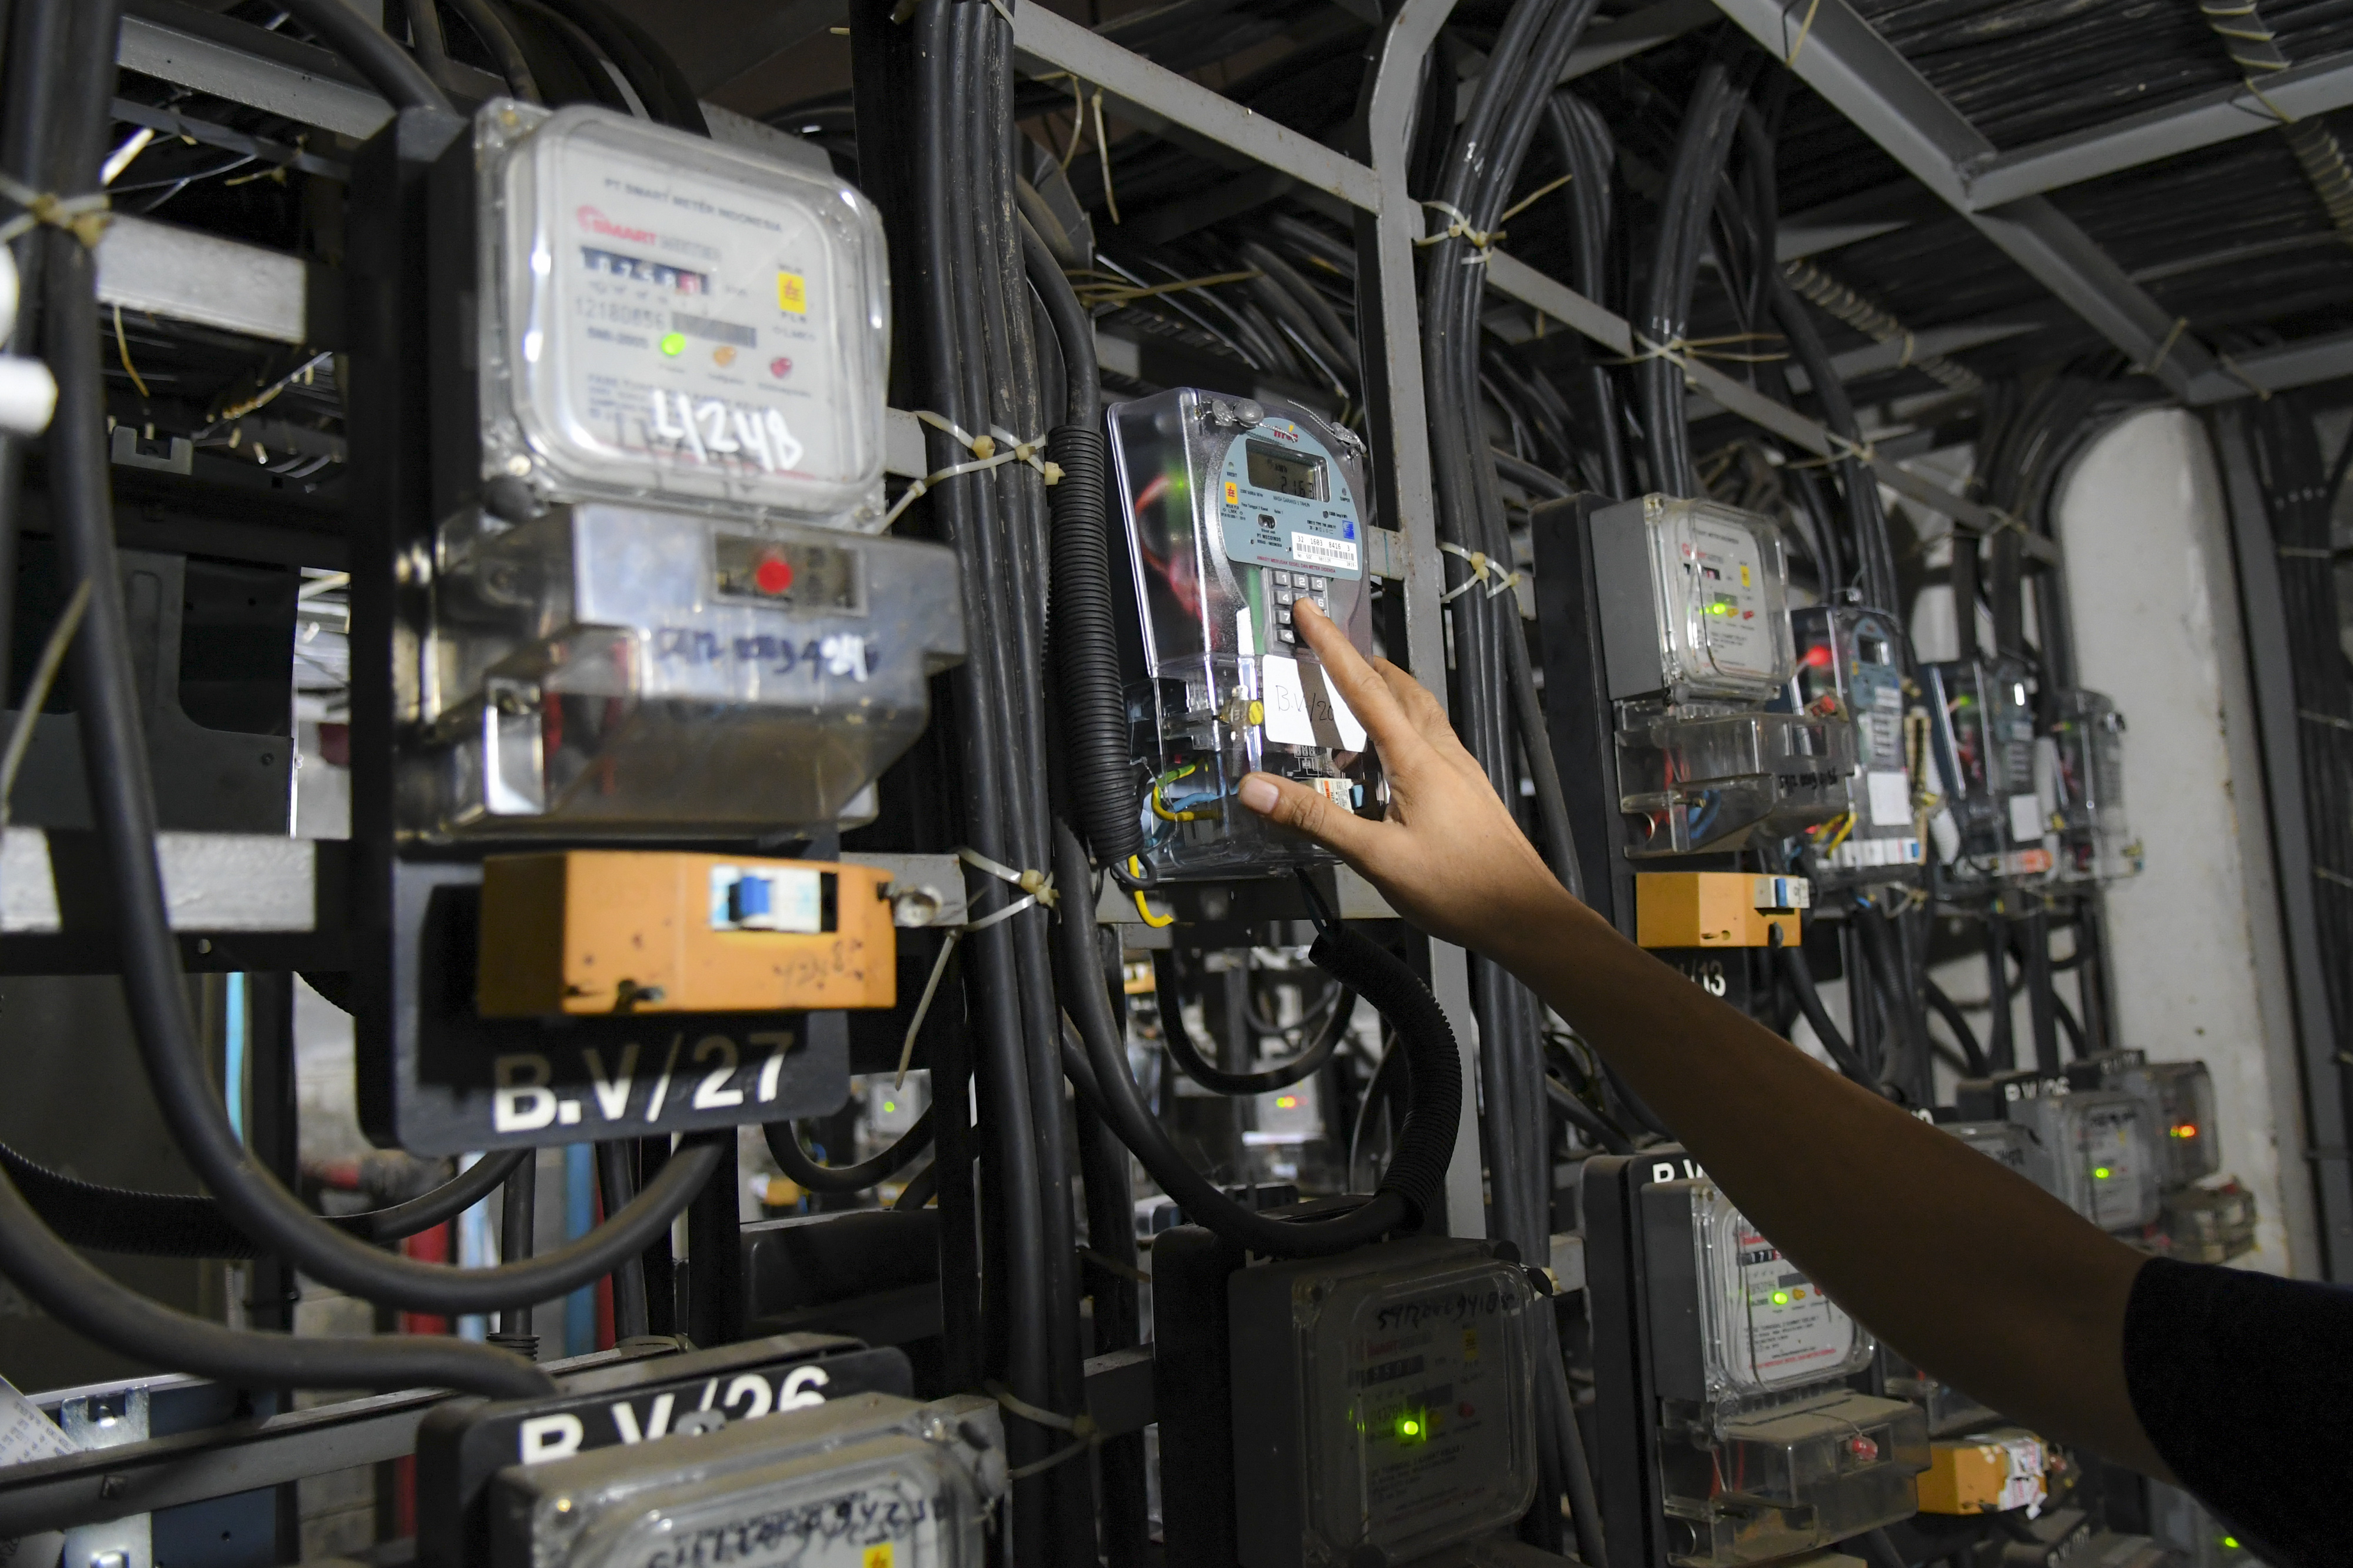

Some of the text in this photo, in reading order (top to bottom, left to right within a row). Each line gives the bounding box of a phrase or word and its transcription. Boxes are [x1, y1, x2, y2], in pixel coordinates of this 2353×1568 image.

[1328, 541, 1341, 550] 8416
[1281, 574, 1323, 588] 1 2 3
[1282, 594, 1324, 607] 4 6
[1284, 613, 1291, 621] 7
[492, 1030, 794, 1133] B.V/27
